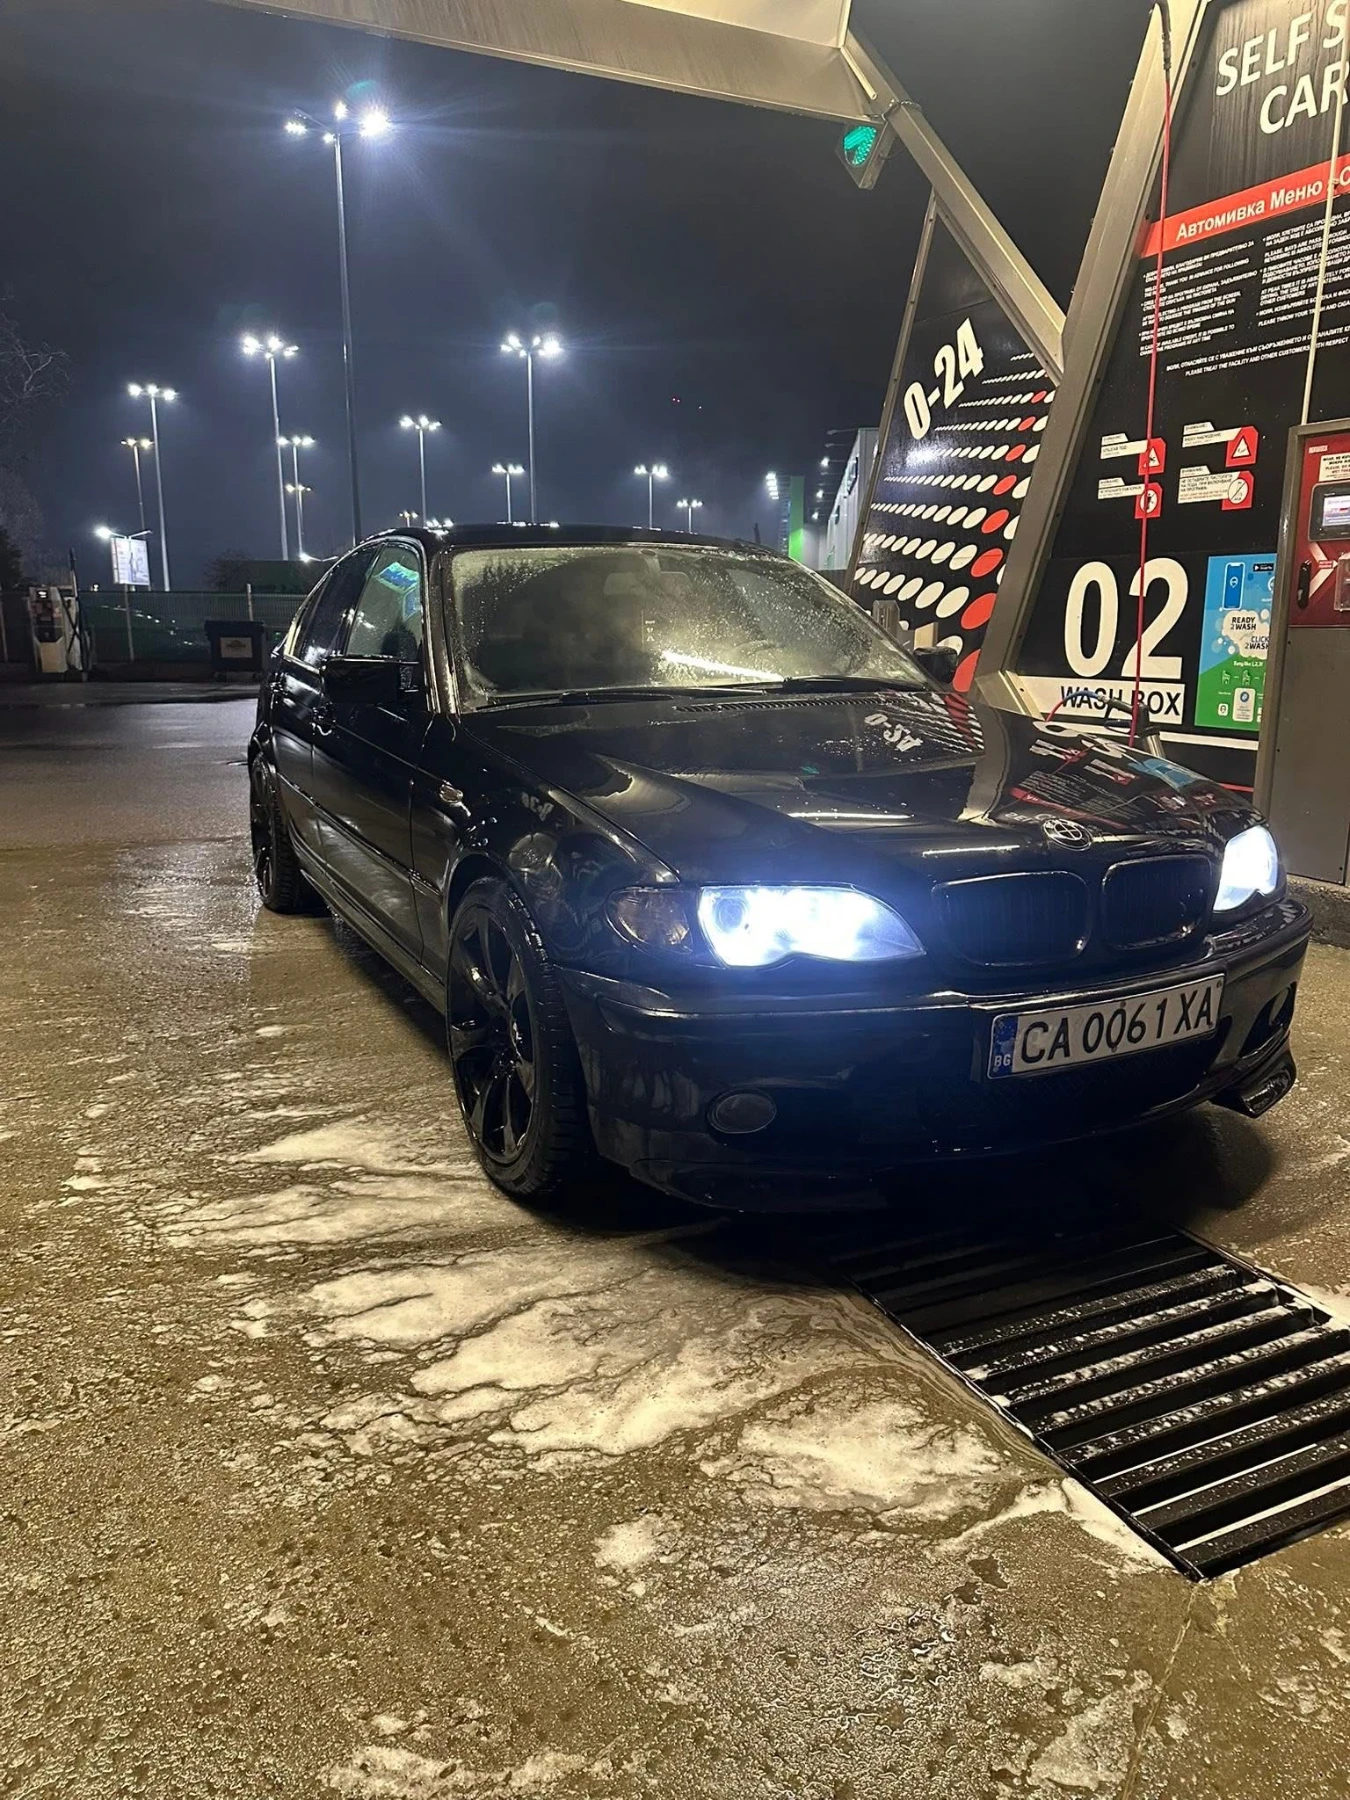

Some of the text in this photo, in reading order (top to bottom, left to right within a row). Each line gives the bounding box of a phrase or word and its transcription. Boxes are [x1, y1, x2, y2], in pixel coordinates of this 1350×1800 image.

[1216, 12, 1313, 96] SELF
[1260, 61, 1350, 135] CAR
[1176, 180, 1323, 241] Автомивка Меню
[1213, 265, 1223, 273] FOR
[903, 318, 984, 440] 0-24
[1185, 367, 1203, 376] PLEASE
[1203, 364, 1218, 372] TREAT
[1228, 358, 1249, 367] FACILITY
[1260, 351, 1278, 360] OTHER
[1278, 345, 1311, 356] CUSTOMERS
[1325, 336, 1349, 346] RESPECT
[1064, 557, 1189, 679] 02
[1232, 616, 1255, 624] READY
[1060, 685, 1123, 711] WASH
[1021, 986, 1213, 1064] CA 0061 XA
[994, 1055, 1012, 1067] BG
